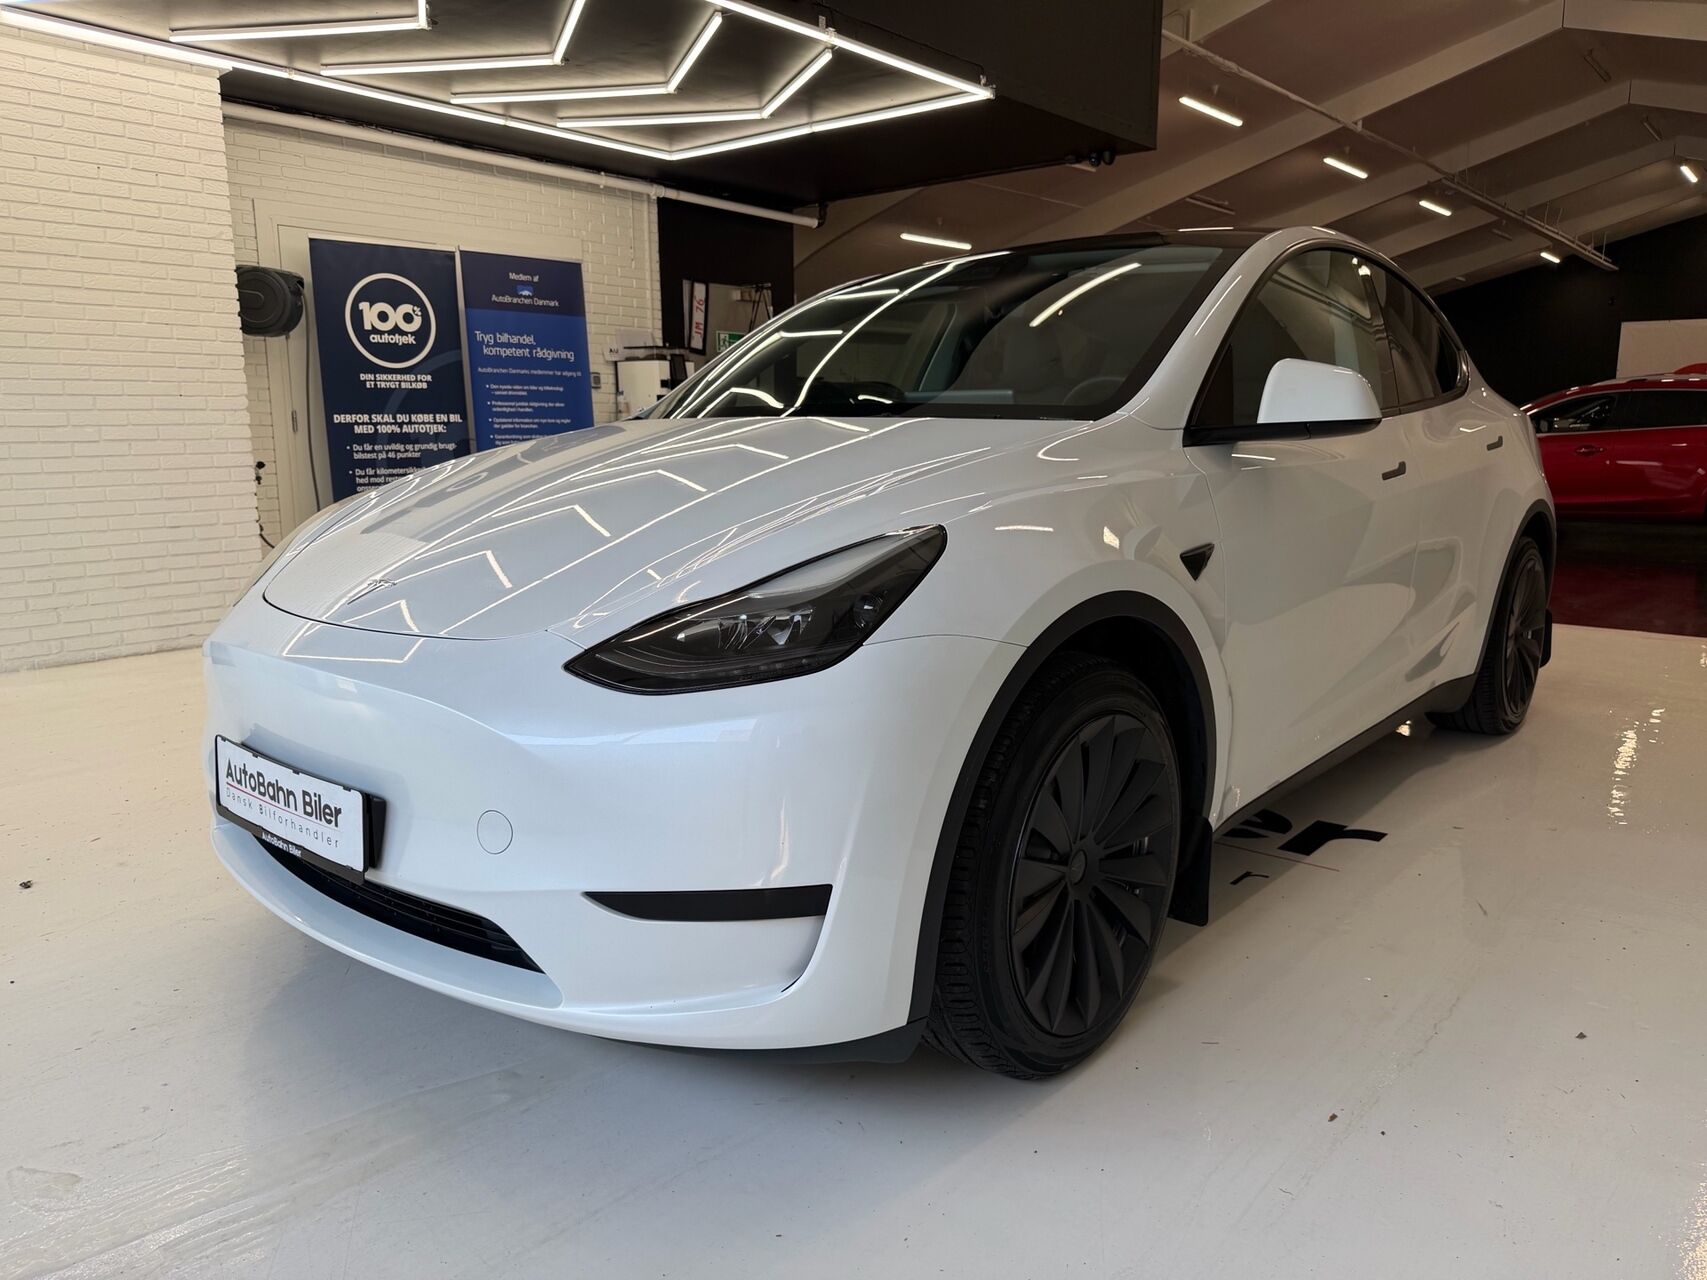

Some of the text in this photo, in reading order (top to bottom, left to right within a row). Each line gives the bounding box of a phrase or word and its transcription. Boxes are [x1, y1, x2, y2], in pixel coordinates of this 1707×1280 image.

[508, 272, 532, 281] Medlem
[491, 294, 559, 307] AutoBranchen Danmark
[358, 301, 423, 333] 100%
[369, 333, 416, 346] autotjek
[474, 331, 536, 345] Tryg bilhandel,
[483, 345, 575, 362] kompetent rådgivning
[333, 414, 463, 423] DERFOR SKAL DU KØBE EN BIL
[354, 424, 447, 435] MED 100% AUTOTJEK:
[363, 443, 373, 451] får
[405, 444, 414, 452] og
[378, 452, 387, 460] på
[387, 451, 396, 459] 46
[396, 451, 422, 460] punkter
[366, 467, 376, 475] får
[225, 758, 342, 828] AutoBahn Biler
[225, 787, 339, 848] Dansk Bilforhandler
[261, 830, 302, 858] AutoBahn Biler
